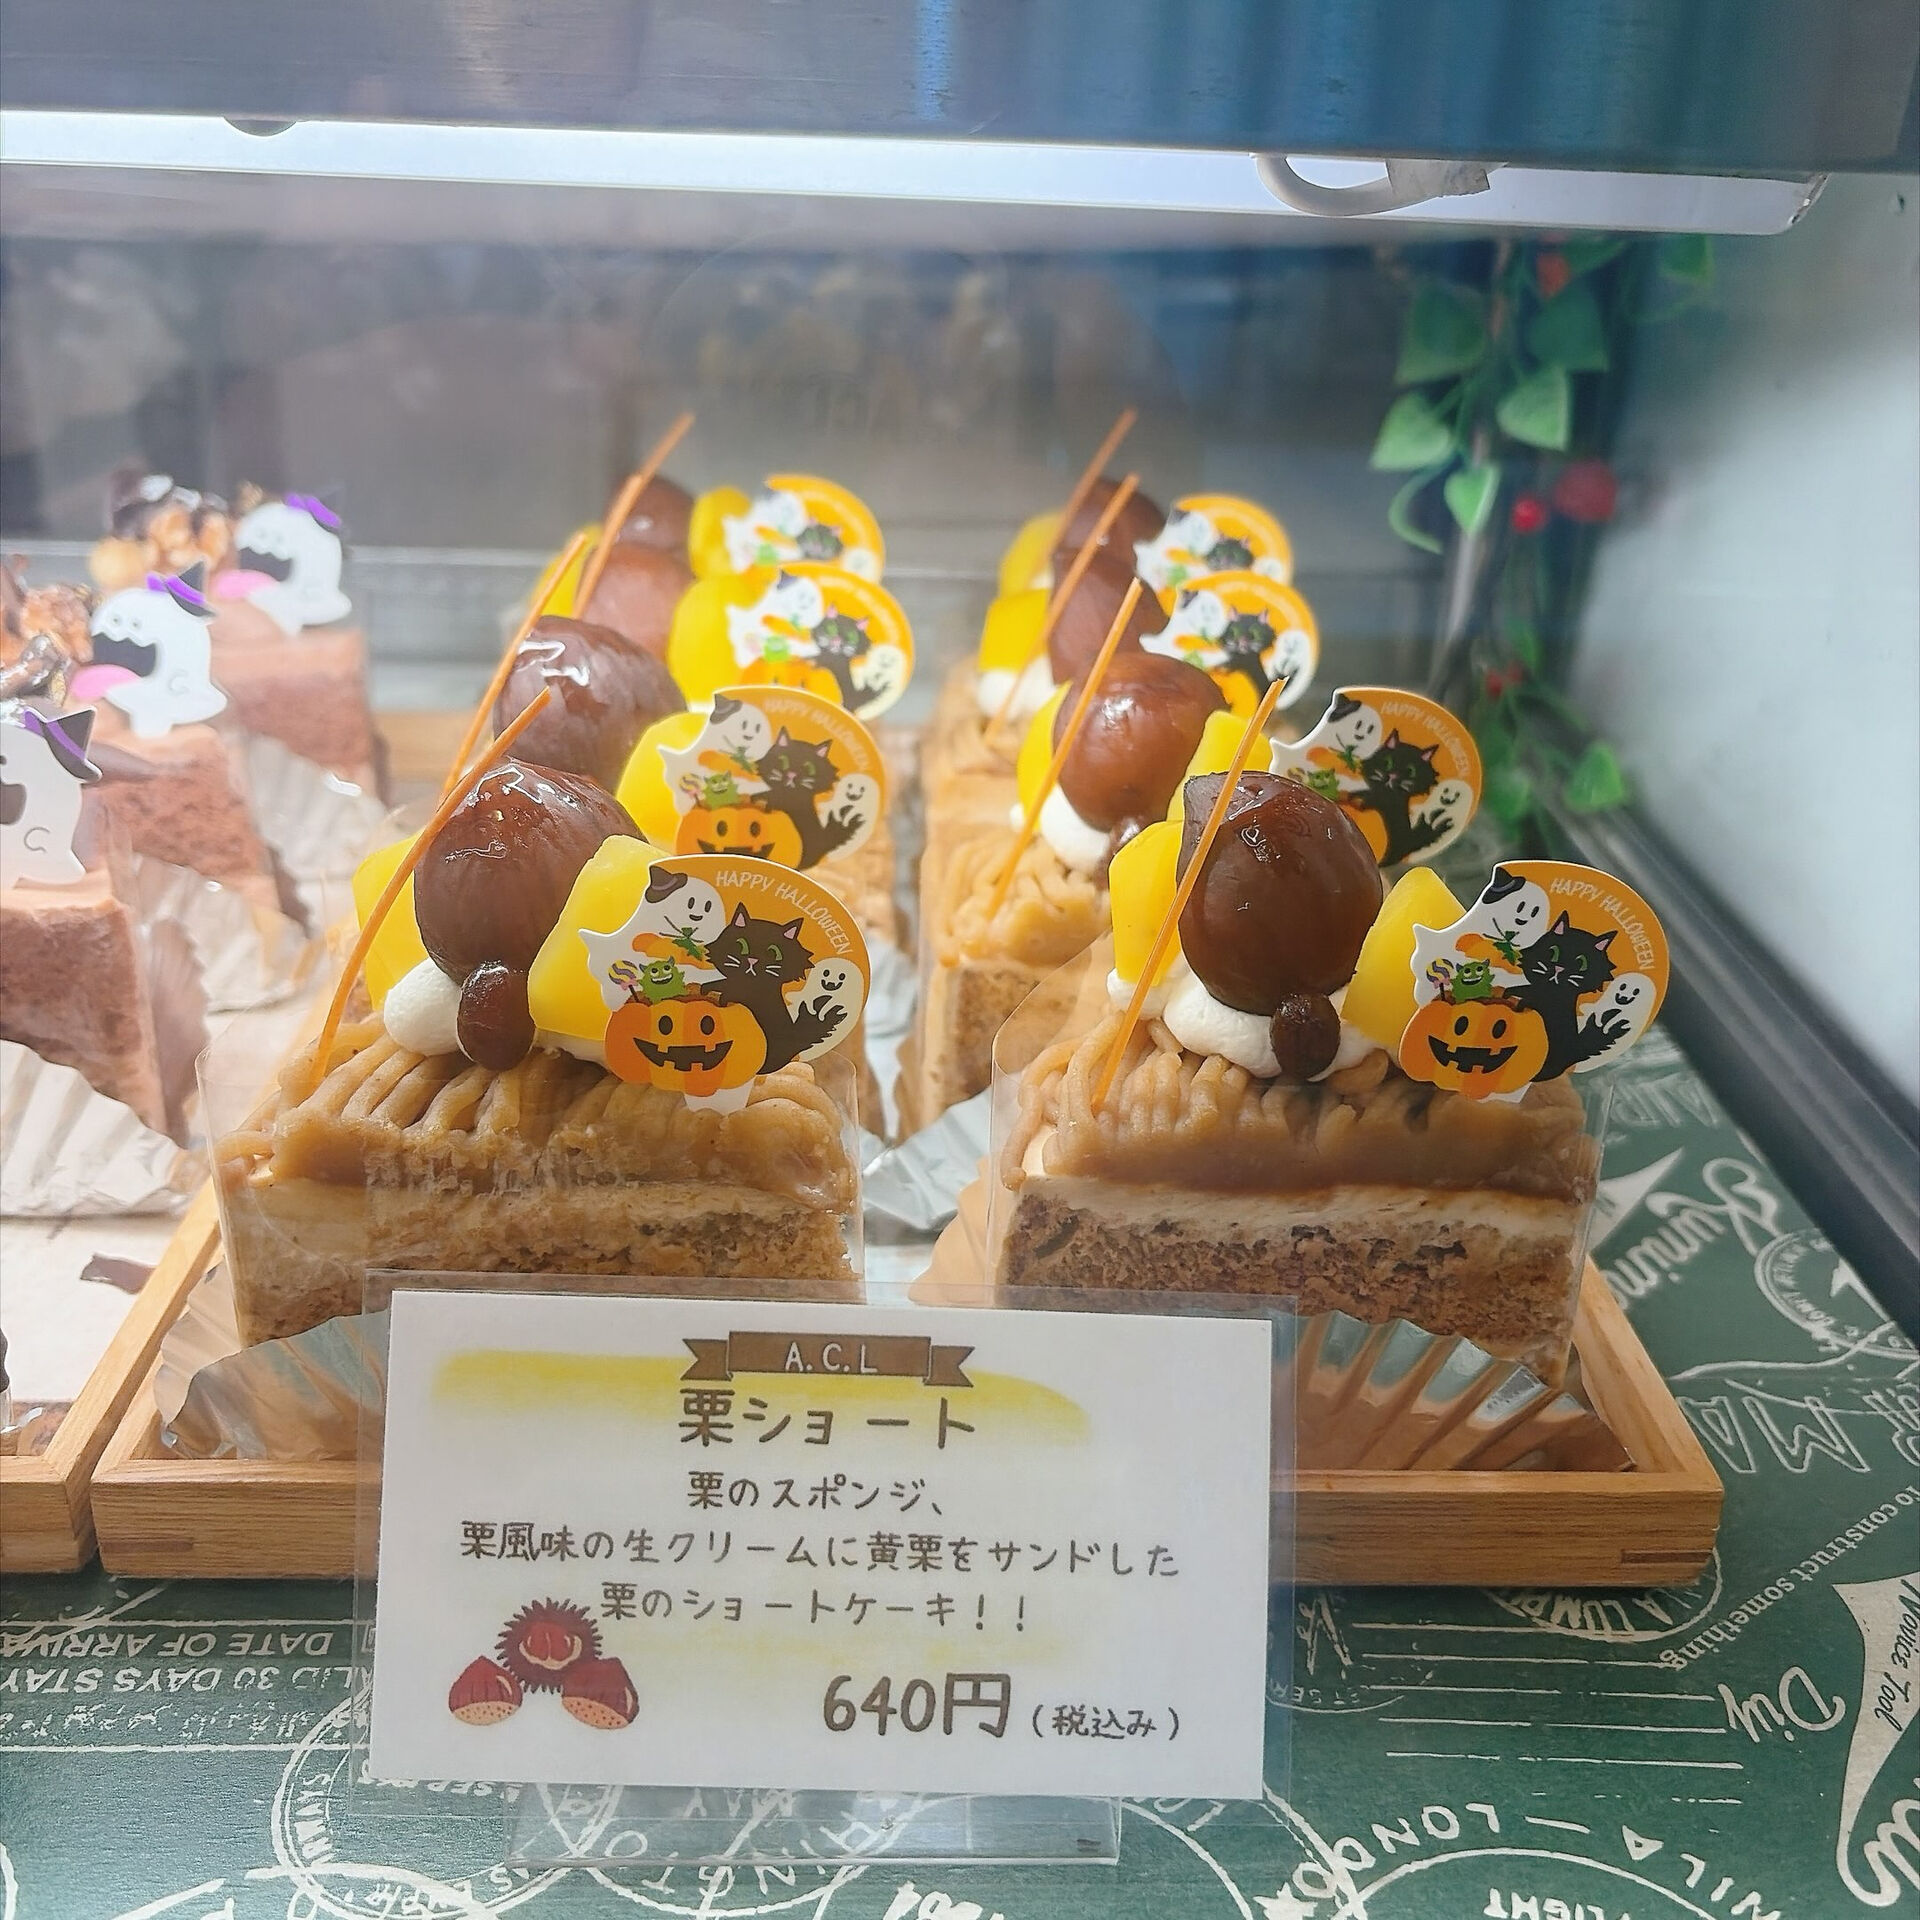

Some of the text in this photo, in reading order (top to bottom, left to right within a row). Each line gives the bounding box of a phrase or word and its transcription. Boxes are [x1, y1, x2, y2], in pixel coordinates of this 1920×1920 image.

[715, 870, 853, 955] HAPPY HALLOWEEN
[1549, 877, 1655, 970] HAPPY HALLOWEEN
[784, 1342, 879, 1374] A.C.L
[679, 1387, 975, 1450] 栗ショート
[688, 1471, 943, 1516] 栗のスポンジ、
[461, 1520, 1179, 1577] 栗風味の生クリームに黄栗をサンドした
[1790, 1500, 1902, 1582] construct
[158, 1632, 217, 1656] OF
[229, 1631, 334, 1656] DATE
[1660, 1574, 1794, 1672] something
[0, 1667, 104, 1694] STAY
[113, 1667, 223, 1693] DAYS
[235, 1666, 280, 1690] 30
[823, 1672, 1180, 1741] 640円 （税込み）
[1717, 1665, 1845, 1744] Diy
[1874, 1671, 1912, 1731] Tool
